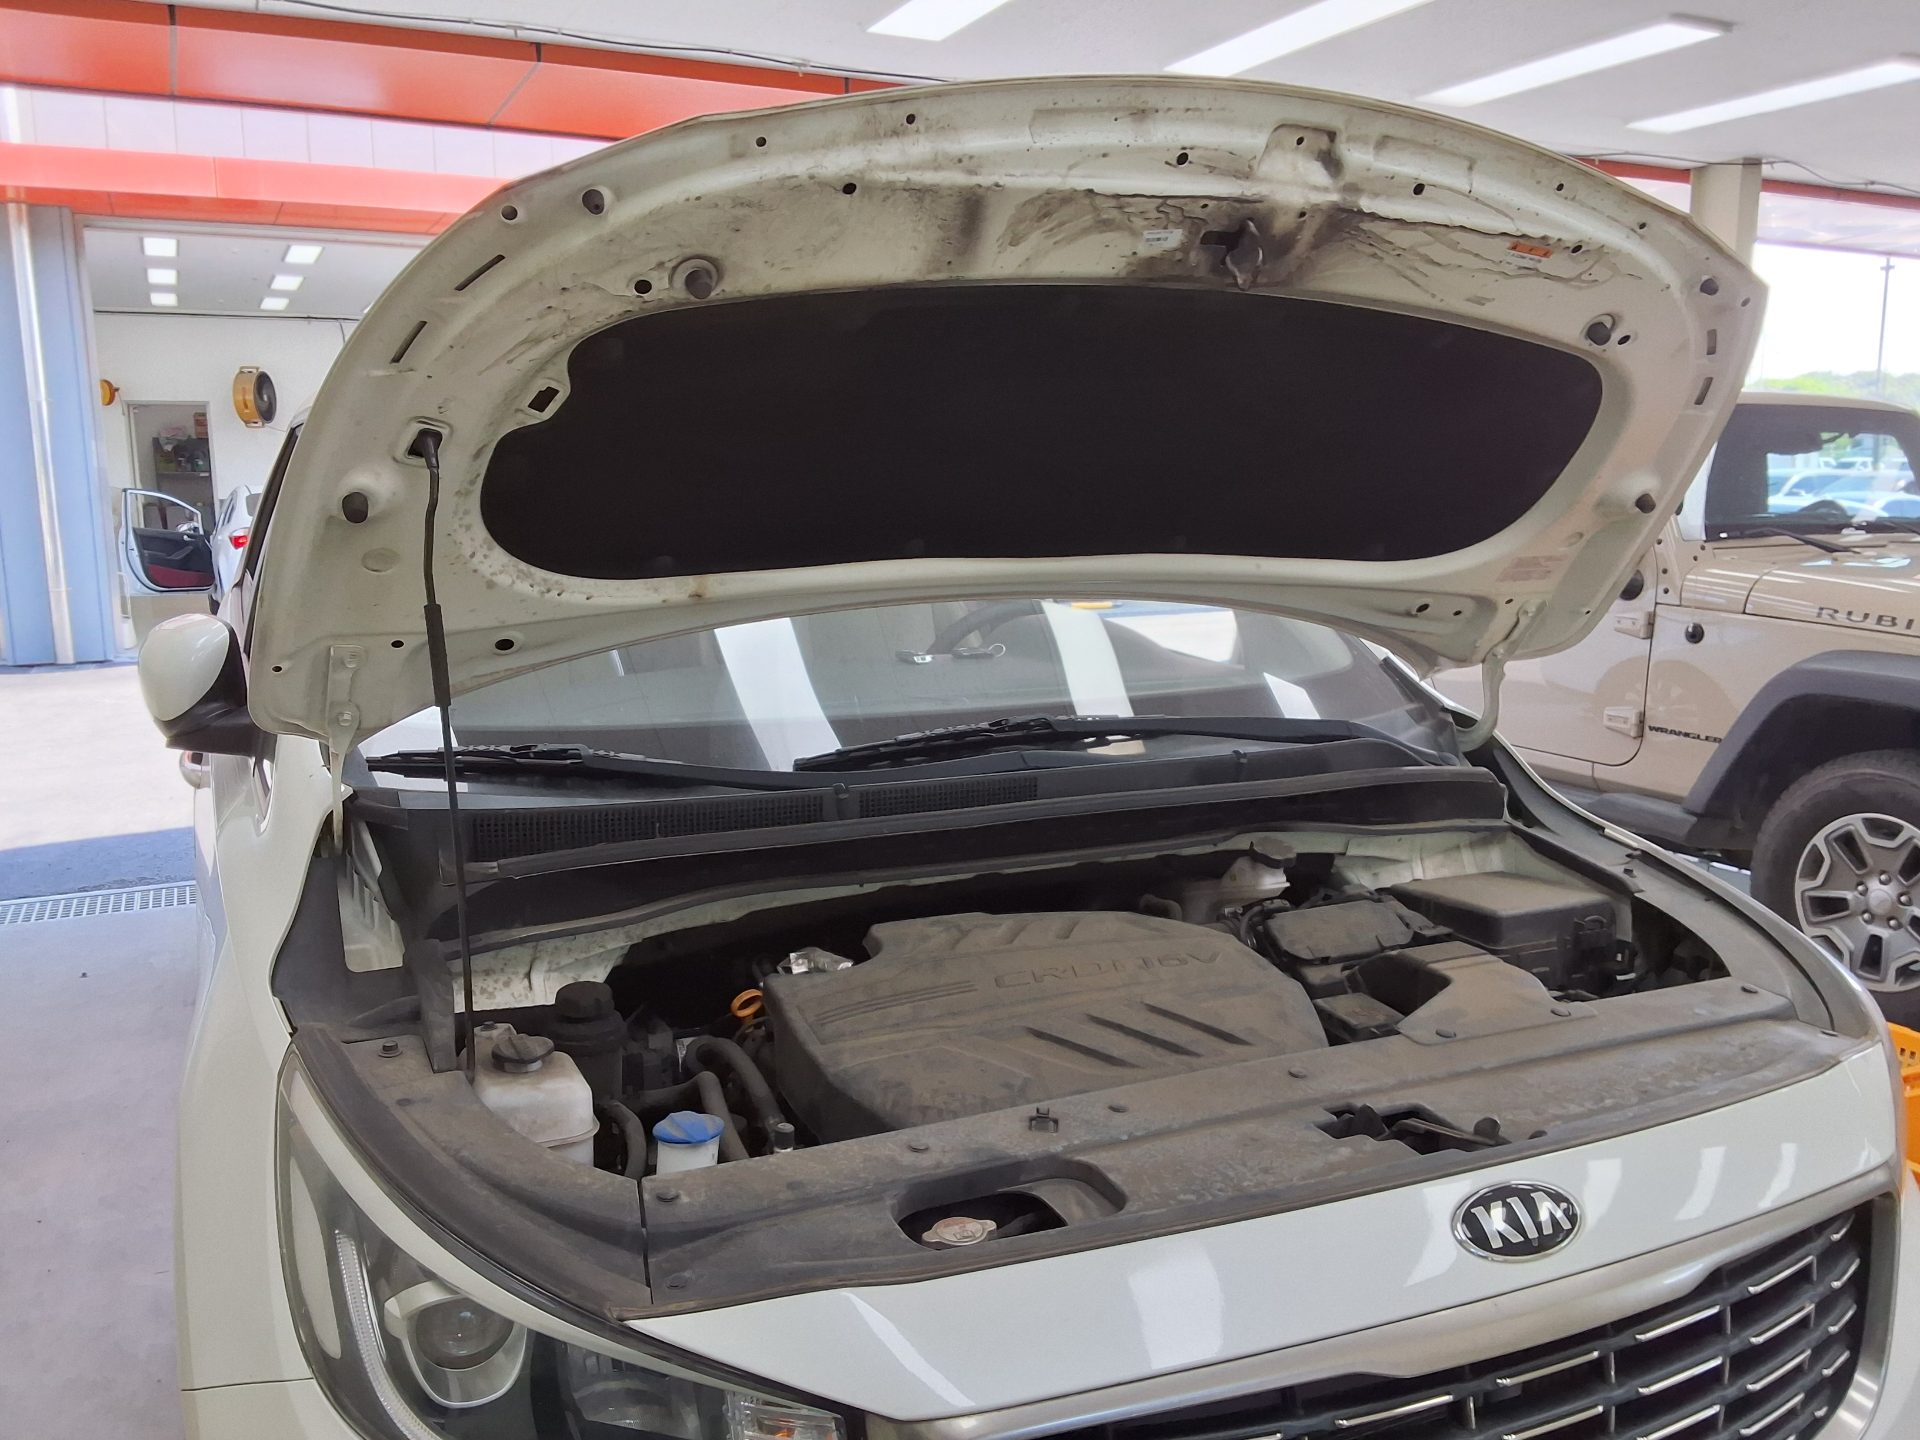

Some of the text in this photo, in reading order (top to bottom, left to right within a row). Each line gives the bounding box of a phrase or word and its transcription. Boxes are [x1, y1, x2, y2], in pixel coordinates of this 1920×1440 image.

[1816, 605, 1915, 630] RUBI
[1647, 725, 1723, 743] WRANGLER
[1470, 1191, 1573, 1249] KIA
